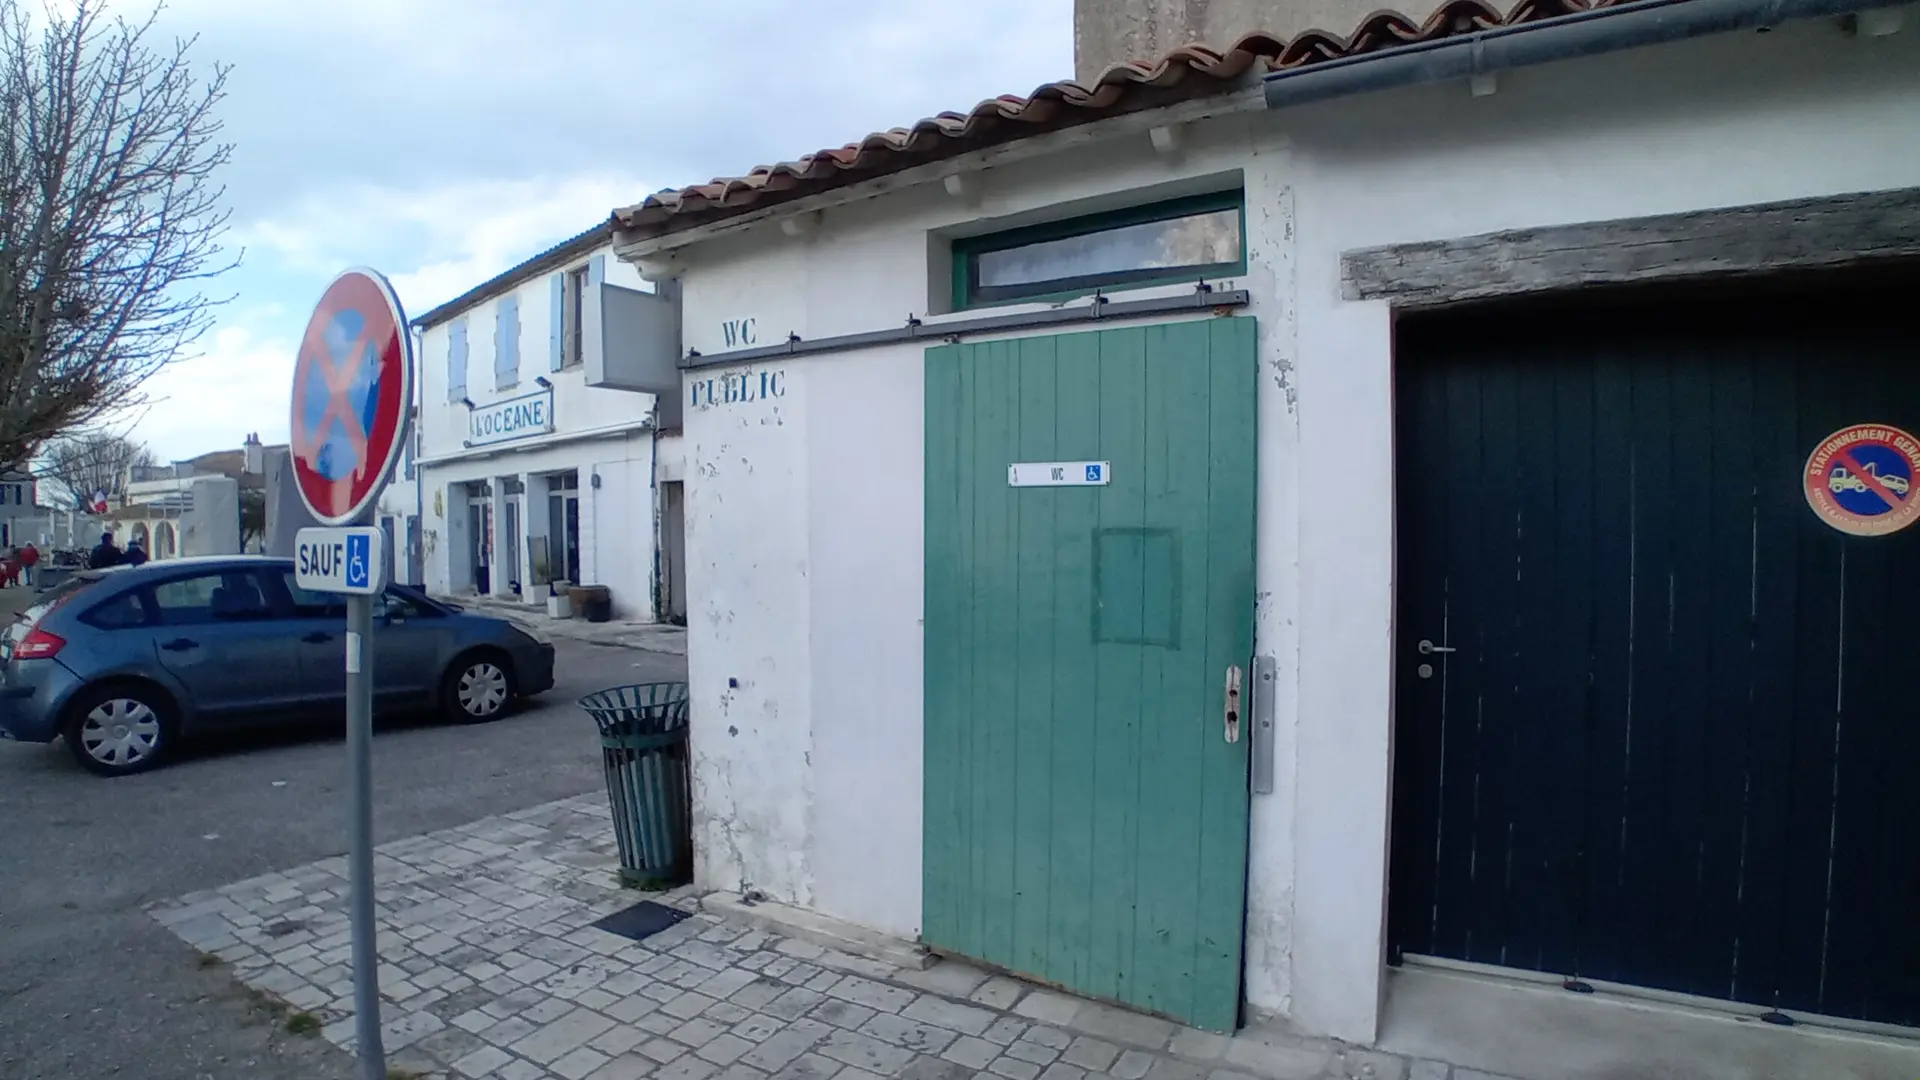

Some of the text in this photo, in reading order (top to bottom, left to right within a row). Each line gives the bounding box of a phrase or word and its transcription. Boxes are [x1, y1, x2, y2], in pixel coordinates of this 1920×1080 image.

[722, 318, 756, 348] WC
[691, 370, 785, 407] PUBLIC
[476, 400, 544, 437] L'OCEANE
[1810, 428, 1894, 476] STATIONNEMENT
[1051, 467, 1064, 481] WC
[300, 543, 342, 577] SAUF
